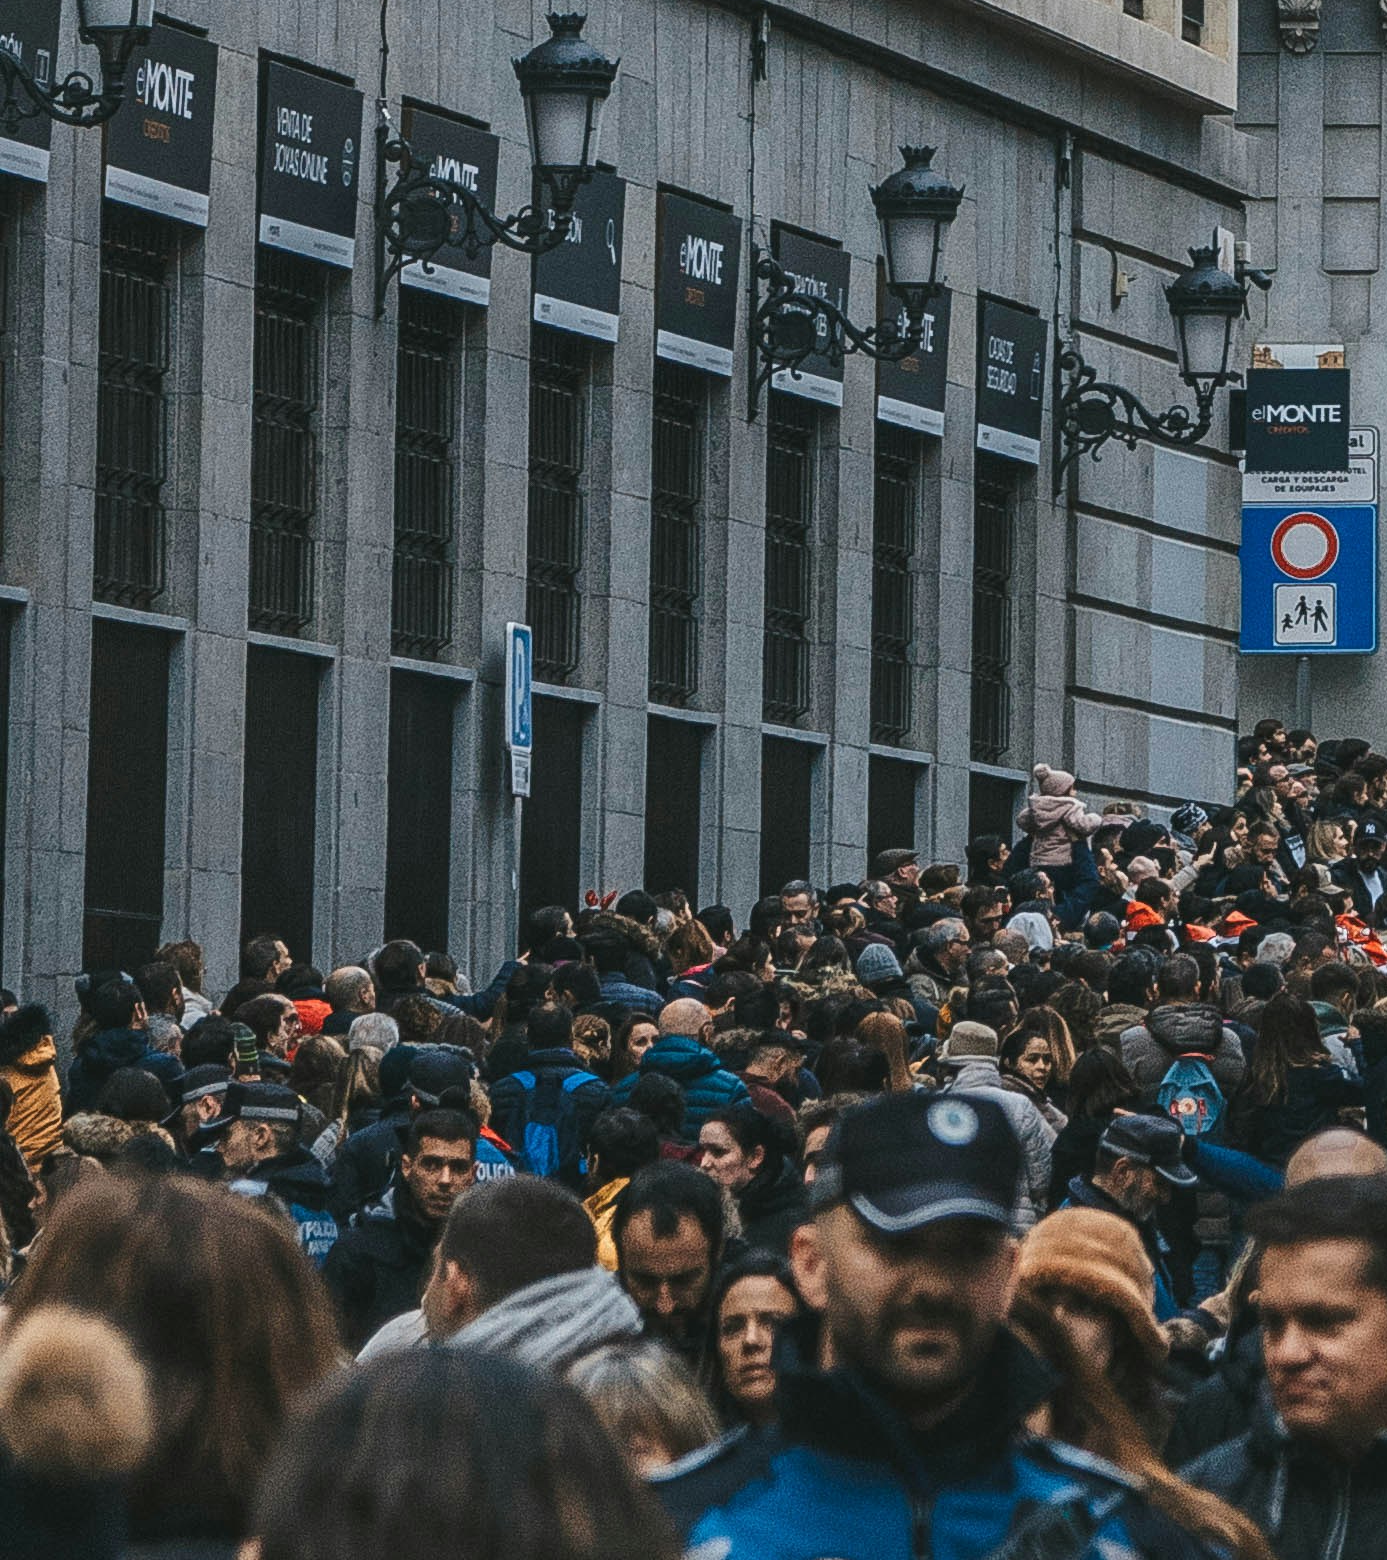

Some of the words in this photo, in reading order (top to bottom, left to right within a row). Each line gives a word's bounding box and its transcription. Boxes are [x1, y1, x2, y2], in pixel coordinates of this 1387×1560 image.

[277, 106, 300, 139] VENTA
[301, 113, 313, 144] DE
[274, 143, 299, 176] JOYAS
[300, 151, 328, 185] ONLINE
[1261, 476, 1290, 484] CARGA
[1302, 475, 1349, 483] DESCARGA
[1289, 484, 1336, 492] EQUIPAJES
[515, 637, 525, 732] P
